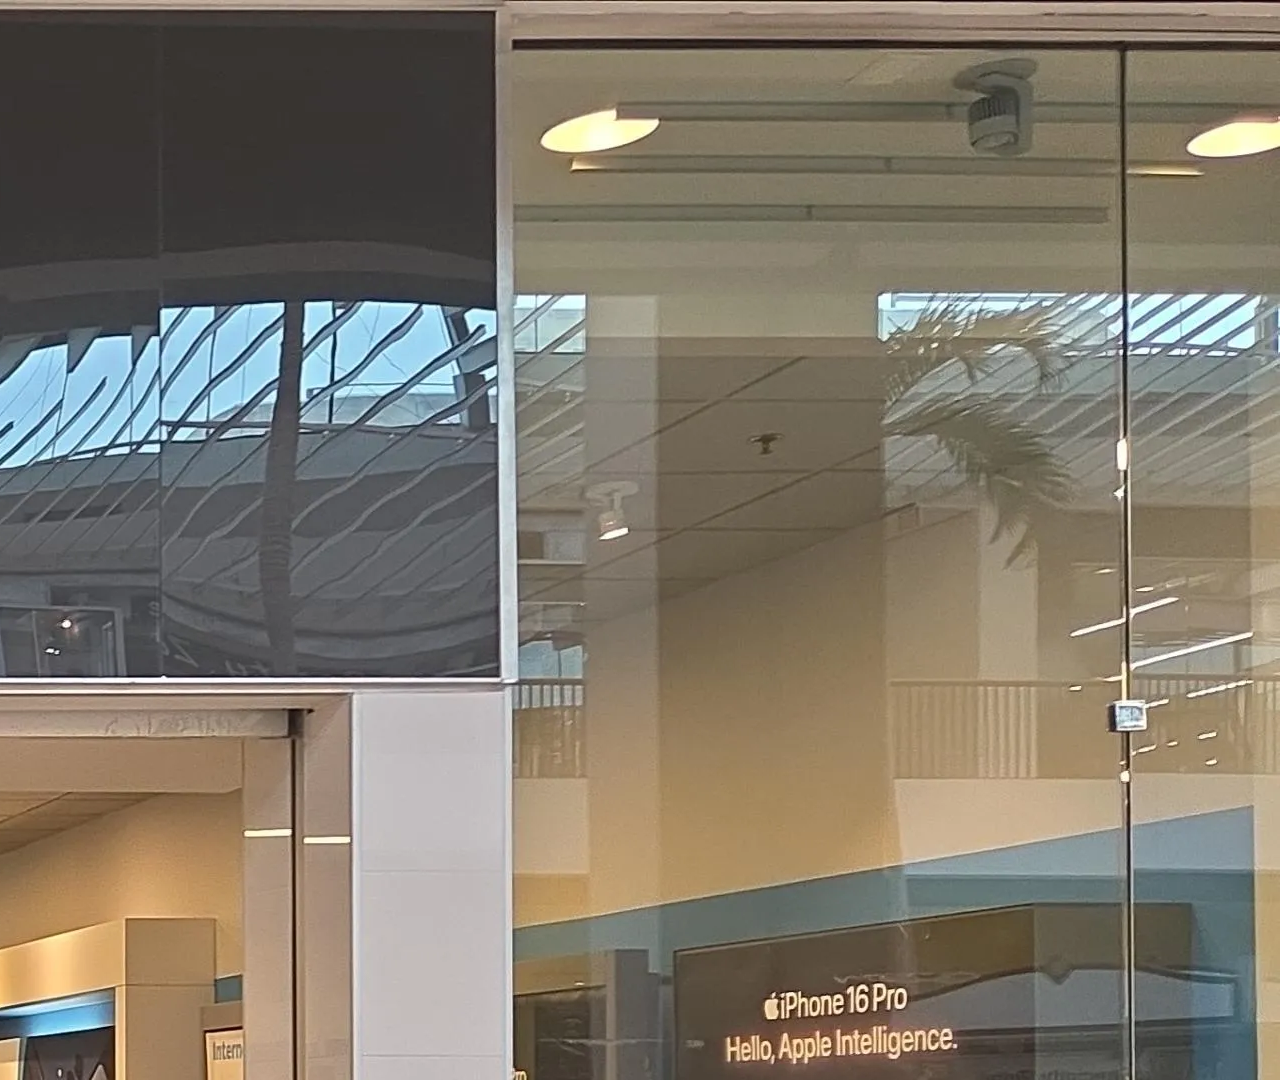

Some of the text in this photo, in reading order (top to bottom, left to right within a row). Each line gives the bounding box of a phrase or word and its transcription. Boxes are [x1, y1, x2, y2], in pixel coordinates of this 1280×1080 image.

[780, 983, 908, 1020] iPhone 16 Pro
[725, 1026, 958, 1065] Hello, Apple Intelligence.
